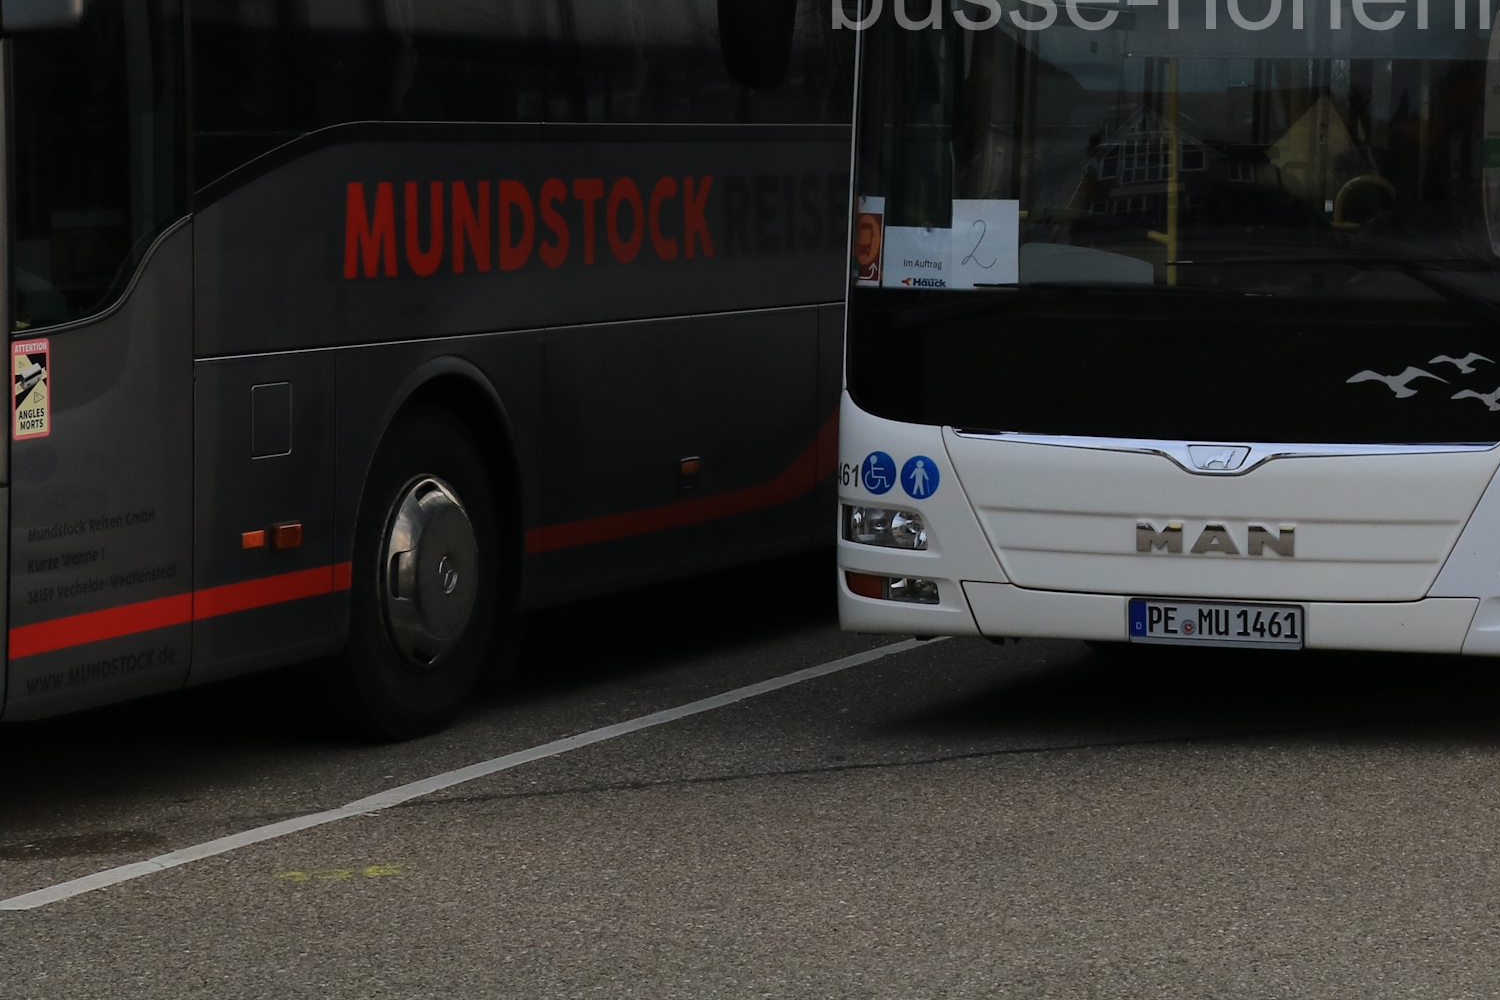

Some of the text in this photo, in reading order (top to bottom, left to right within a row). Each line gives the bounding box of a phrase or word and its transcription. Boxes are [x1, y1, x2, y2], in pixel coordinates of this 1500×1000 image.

[343, 174, 716, 281] MUNDSTOCK
[961, 219, 998, 270] 2
[903, 259, 943, 271] Im Auftrag
[913, 277, 947, 288] Hauck
[14, 341, 48, 354] ATTENTION
[18, 408, 45, 421] ANGLES
[20, 418, 44, 431] MORTS
[27, 509, 156, 543] Mundstock Reisen GmbH
[1135, 518, 1297, 557] MAN
[27, 547, 105, 574] Kurze Wanne 1
[26, 587, 55, 606] 38159
[1134, 605, 1299, 640] D PE MU 1461
[25, 645, 177, 696] www.MUNDSTOCK.de
